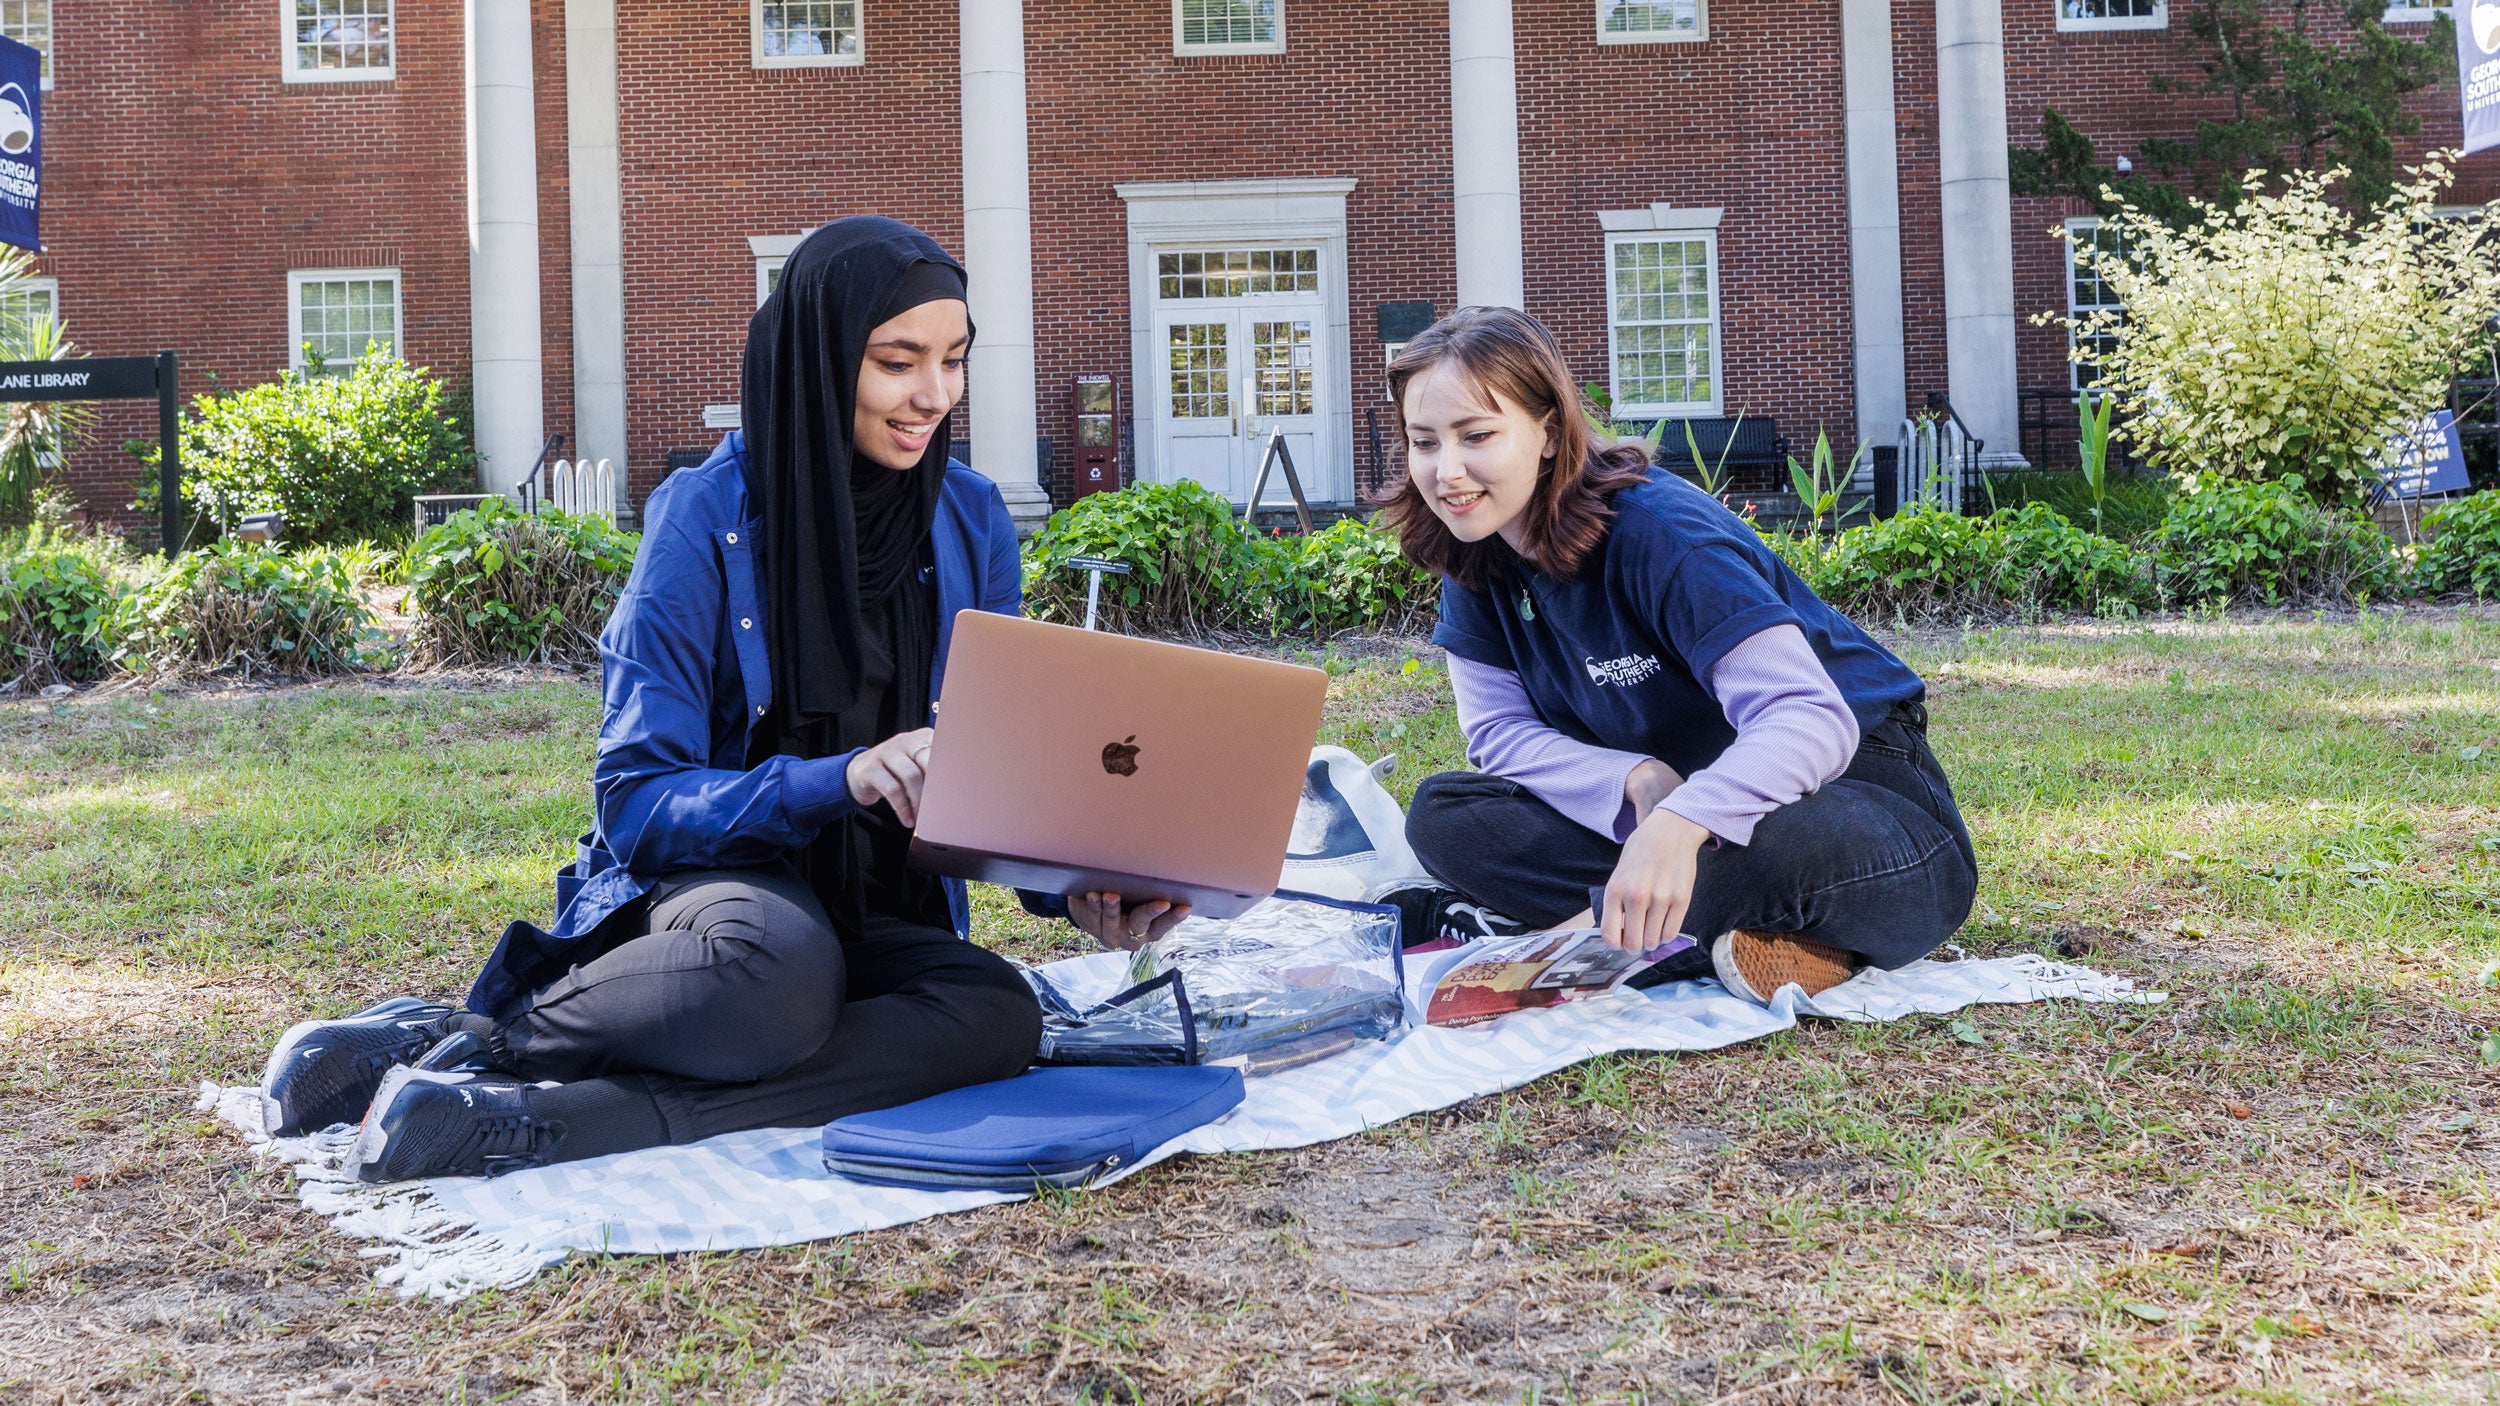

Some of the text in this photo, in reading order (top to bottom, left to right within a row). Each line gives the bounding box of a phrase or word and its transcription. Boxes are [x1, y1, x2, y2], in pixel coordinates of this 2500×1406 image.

[2470, 58, 2500, 83] GEOR
[0, 157, 36, 183] ORGIA
[33, 372, 90, 388] LIBRARY
[1607, 654, 1659, 682] OUTHERN
[1448, 1016, 1469, 1025] Doing
